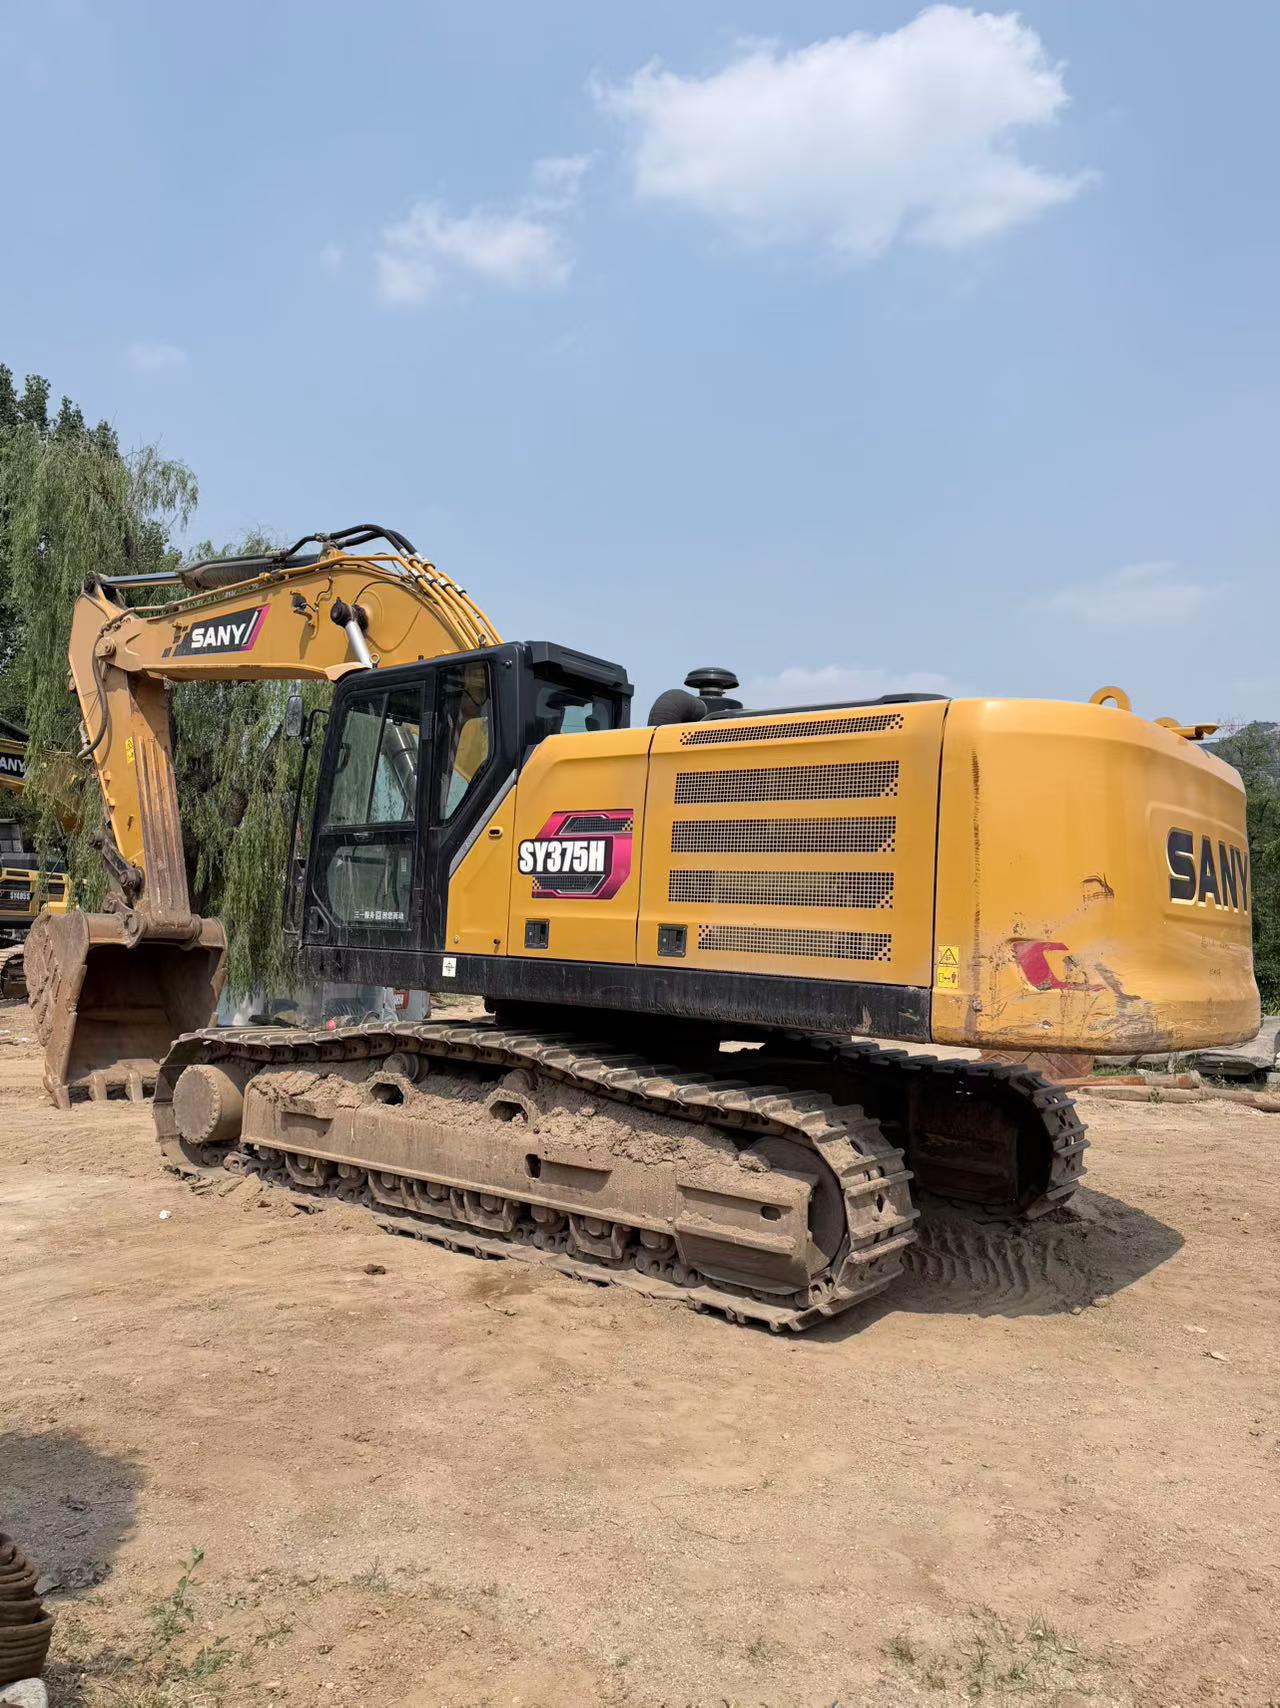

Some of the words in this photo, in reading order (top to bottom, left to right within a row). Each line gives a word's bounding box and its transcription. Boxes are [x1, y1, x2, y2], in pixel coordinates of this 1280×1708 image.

[191, 624, 246, 649] SANY
[519, 840, 606, 873] SY375H
[1166, 827, 1249, 915] SANY
